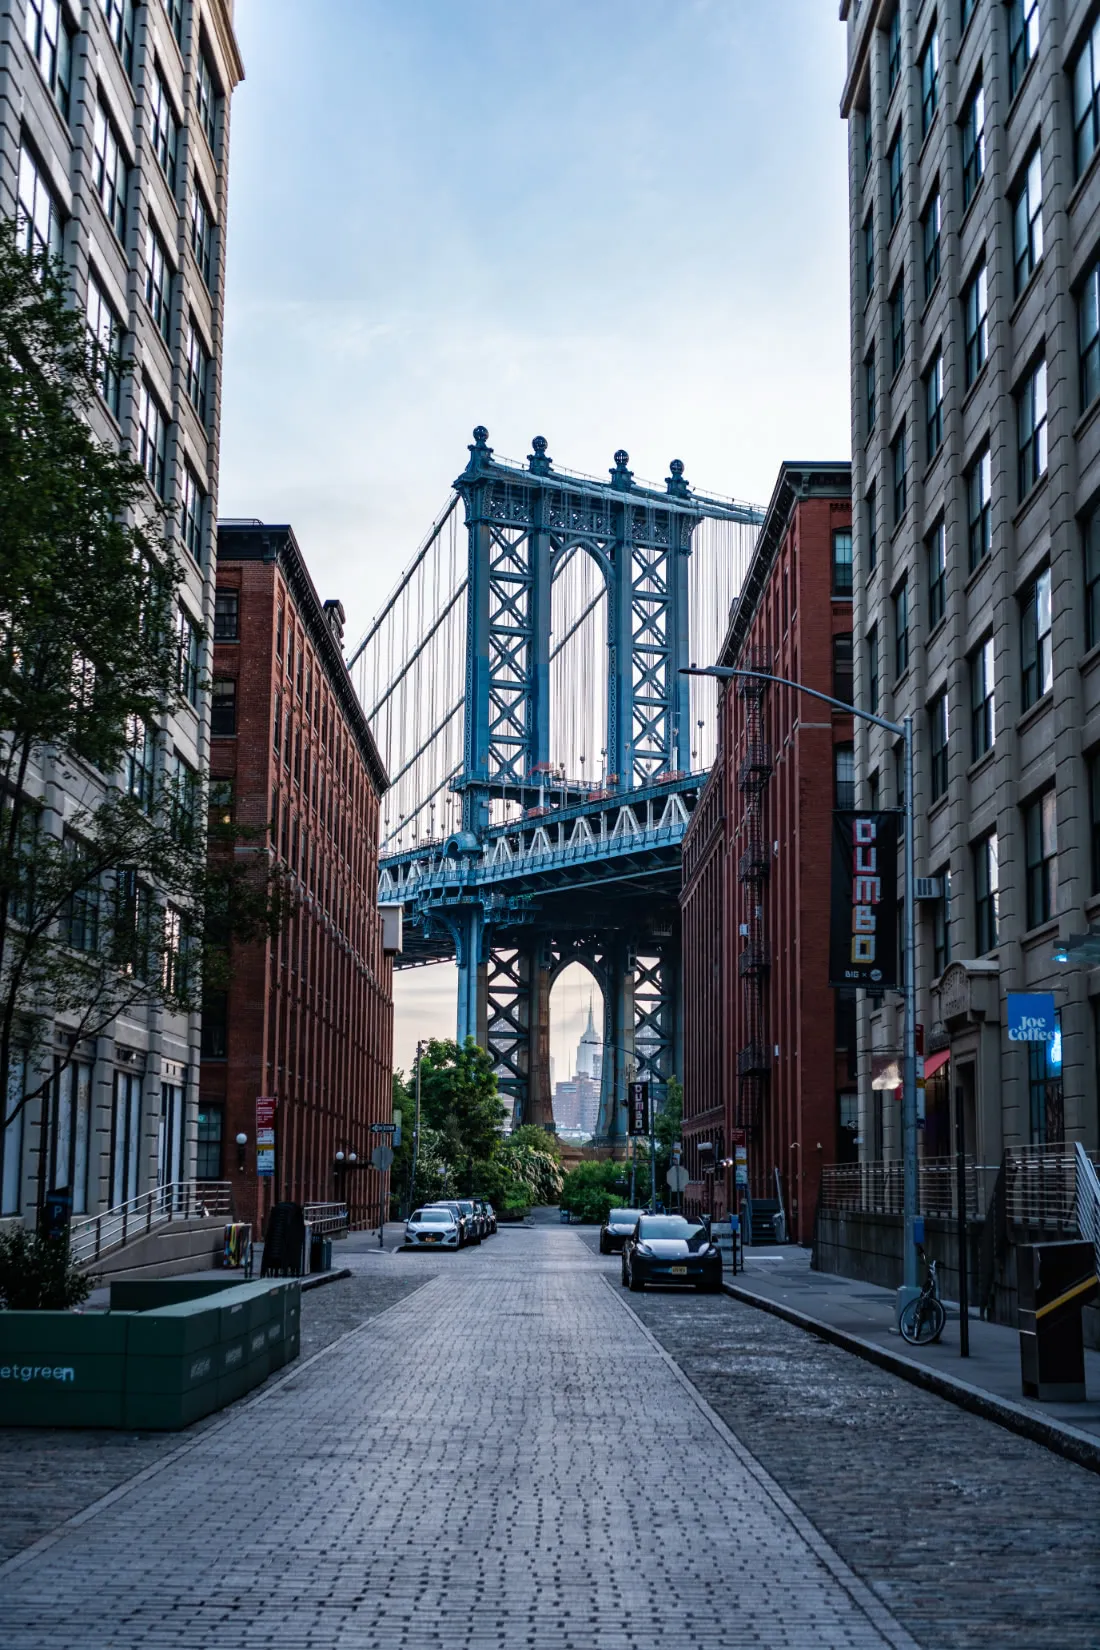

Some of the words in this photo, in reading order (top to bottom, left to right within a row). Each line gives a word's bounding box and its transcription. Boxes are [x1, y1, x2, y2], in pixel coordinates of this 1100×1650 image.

[851, 819, 881, 964] DUMBO
[1008, 1028, 1056, 1041] Coffee
[1018, 1016, 1046, 1031] Joe
[635, 1085, 643, 1128] DUMBO
